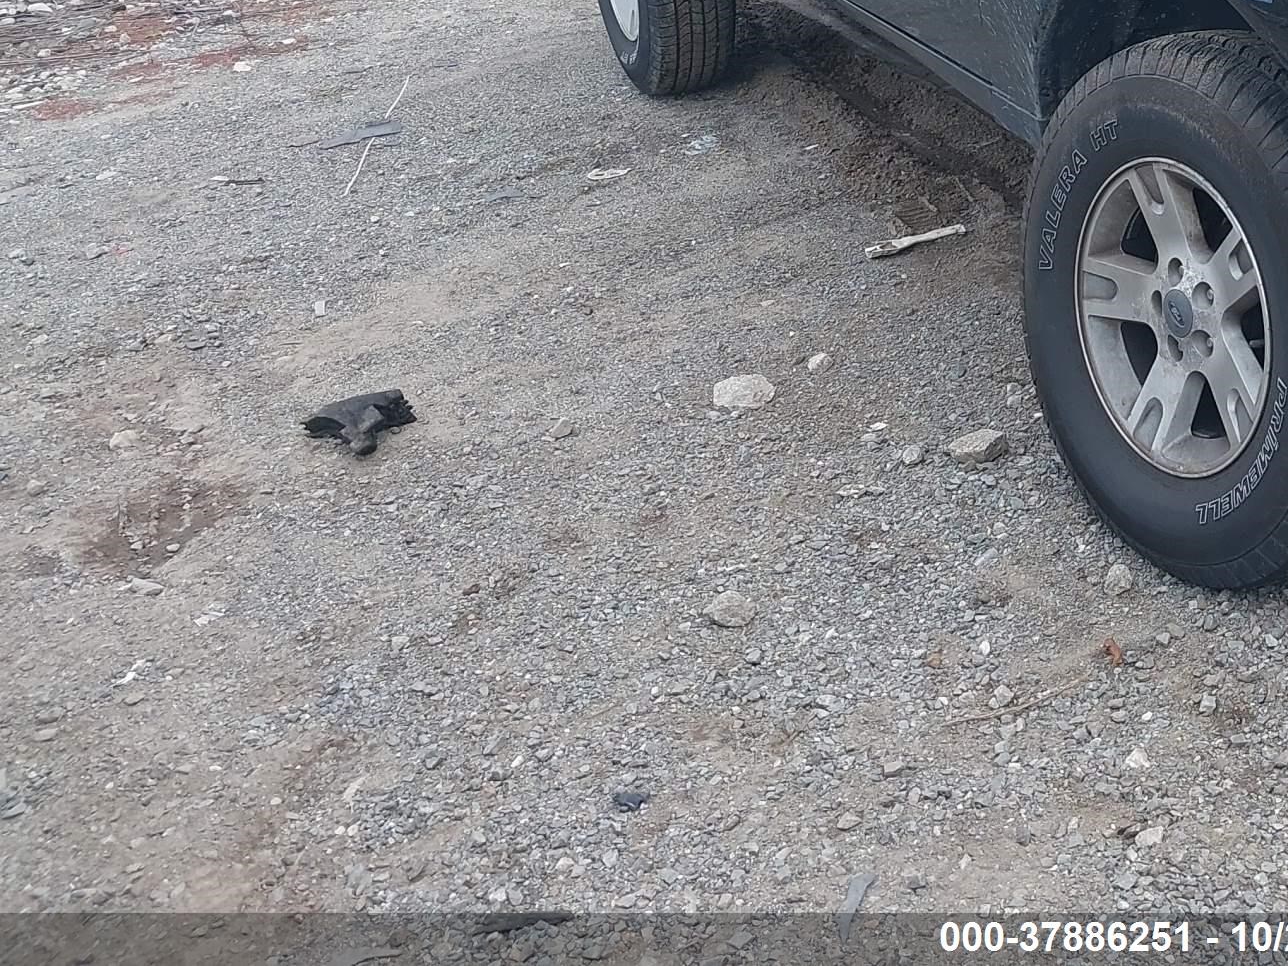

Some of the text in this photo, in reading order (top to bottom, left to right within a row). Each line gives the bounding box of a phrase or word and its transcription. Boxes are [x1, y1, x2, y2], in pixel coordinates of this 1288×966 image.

[1039, 118, 1118, 270] VALERA HT
[1195, 376, 1288, 525] PRIMEWELL
